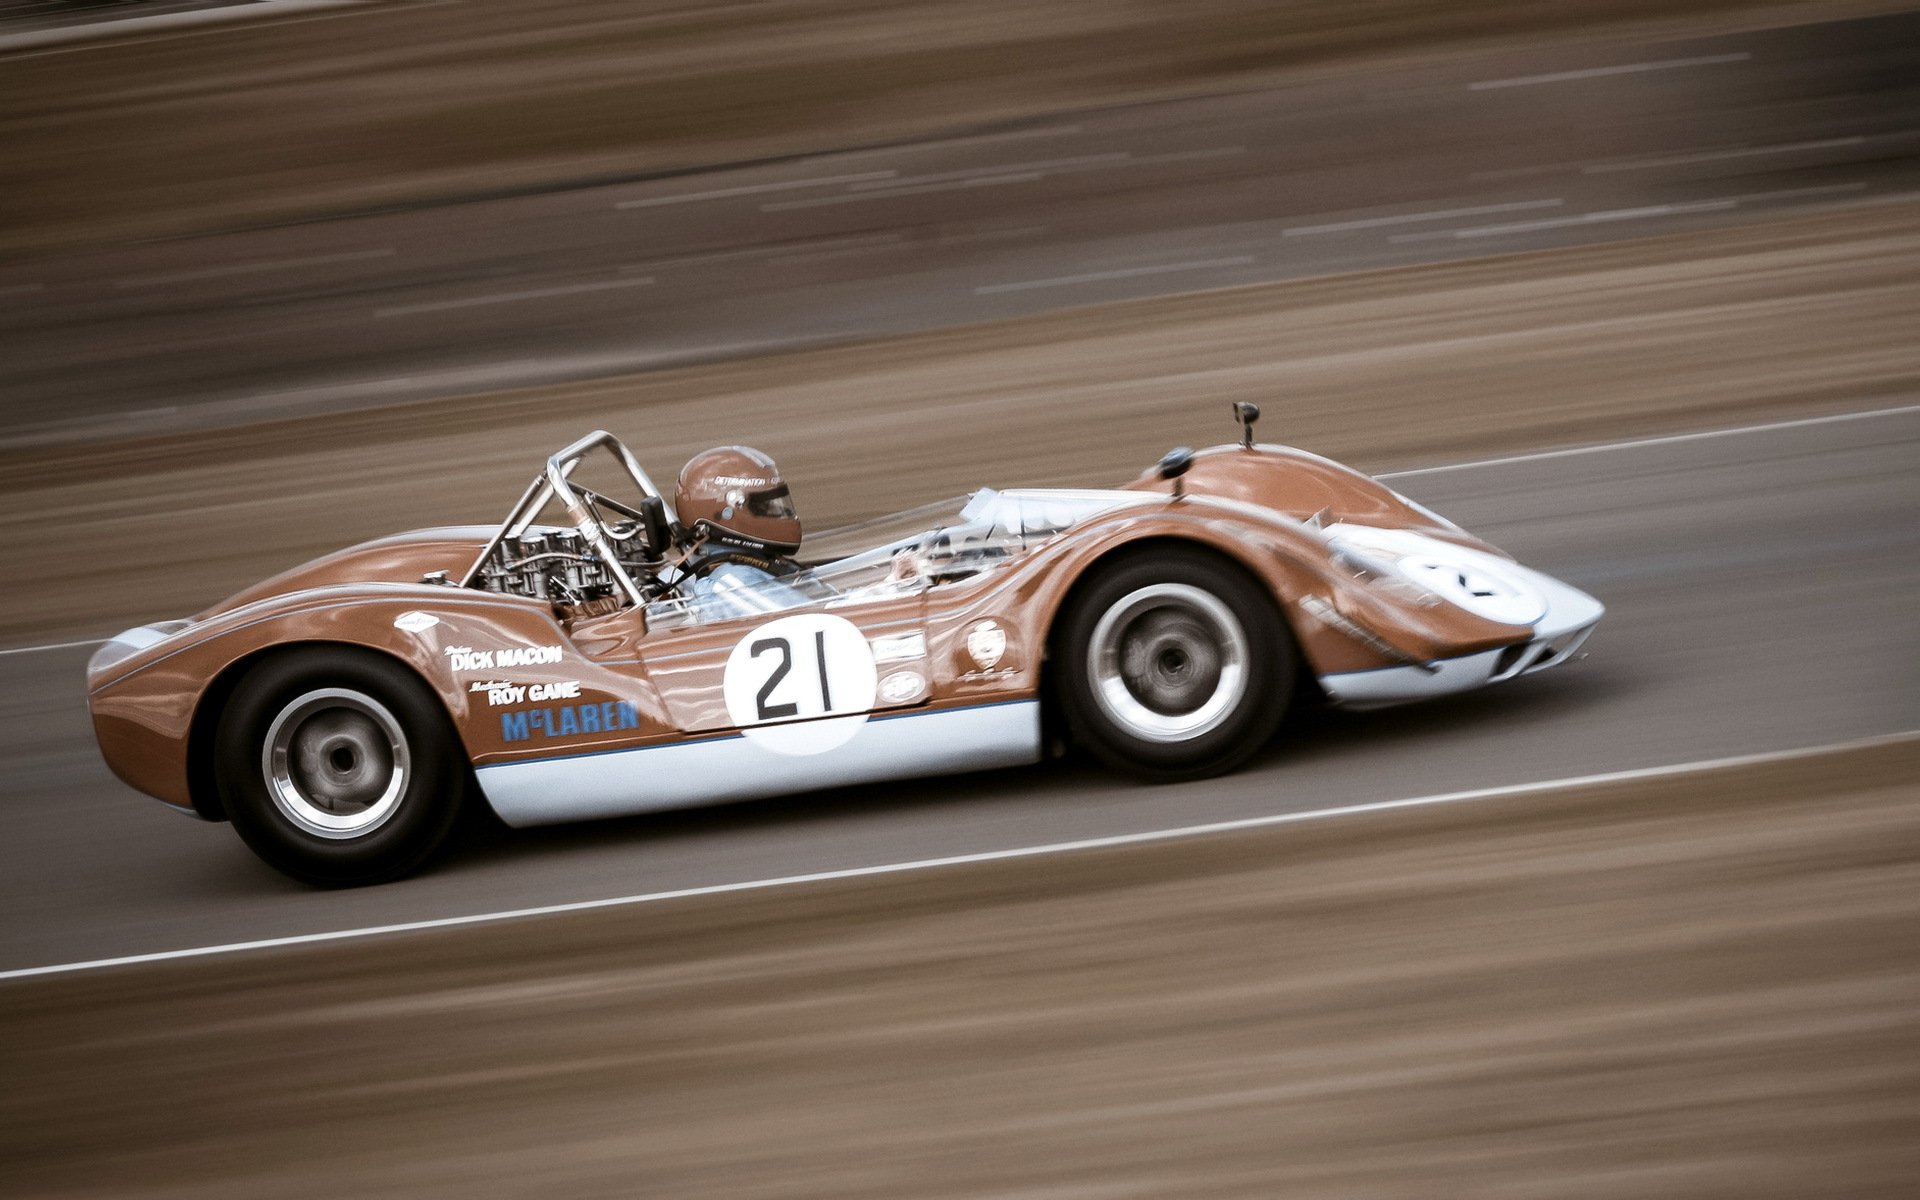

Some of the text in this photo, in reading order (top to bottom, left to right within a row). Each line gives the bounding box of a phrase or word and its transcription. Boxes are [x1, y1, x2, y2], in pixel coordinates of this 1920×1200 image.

[451, 646, 562, 672] DICK MACON
[750, 631, 832, 720] 21
[488, 687, 526, 706] ROY
